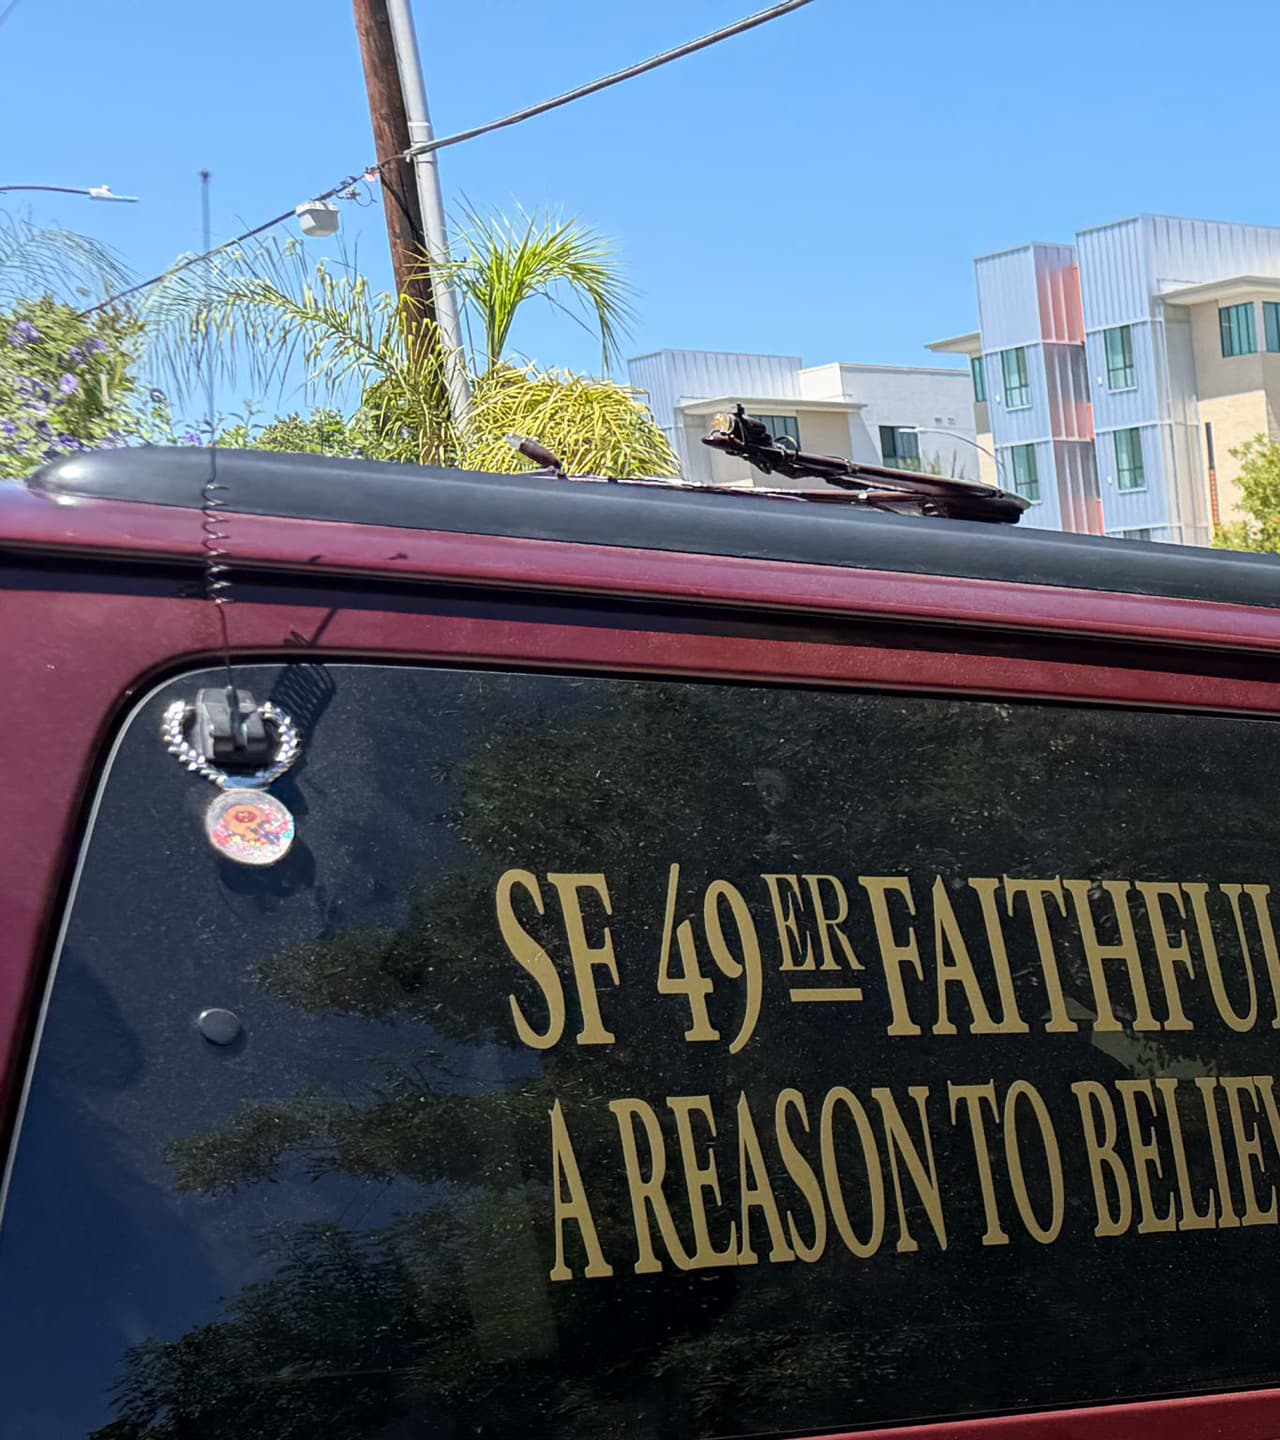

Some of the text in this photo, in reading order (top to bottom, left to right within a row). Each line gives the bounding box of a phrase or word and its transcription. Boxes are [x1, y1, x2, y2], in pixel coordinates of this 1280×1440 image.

[496, 869, 621, 1049] SF
[549, 1097, 613, 1282] A
[609, 1085, 948, 1275] REASON
[949, 1079, 1066, 1246] TO
